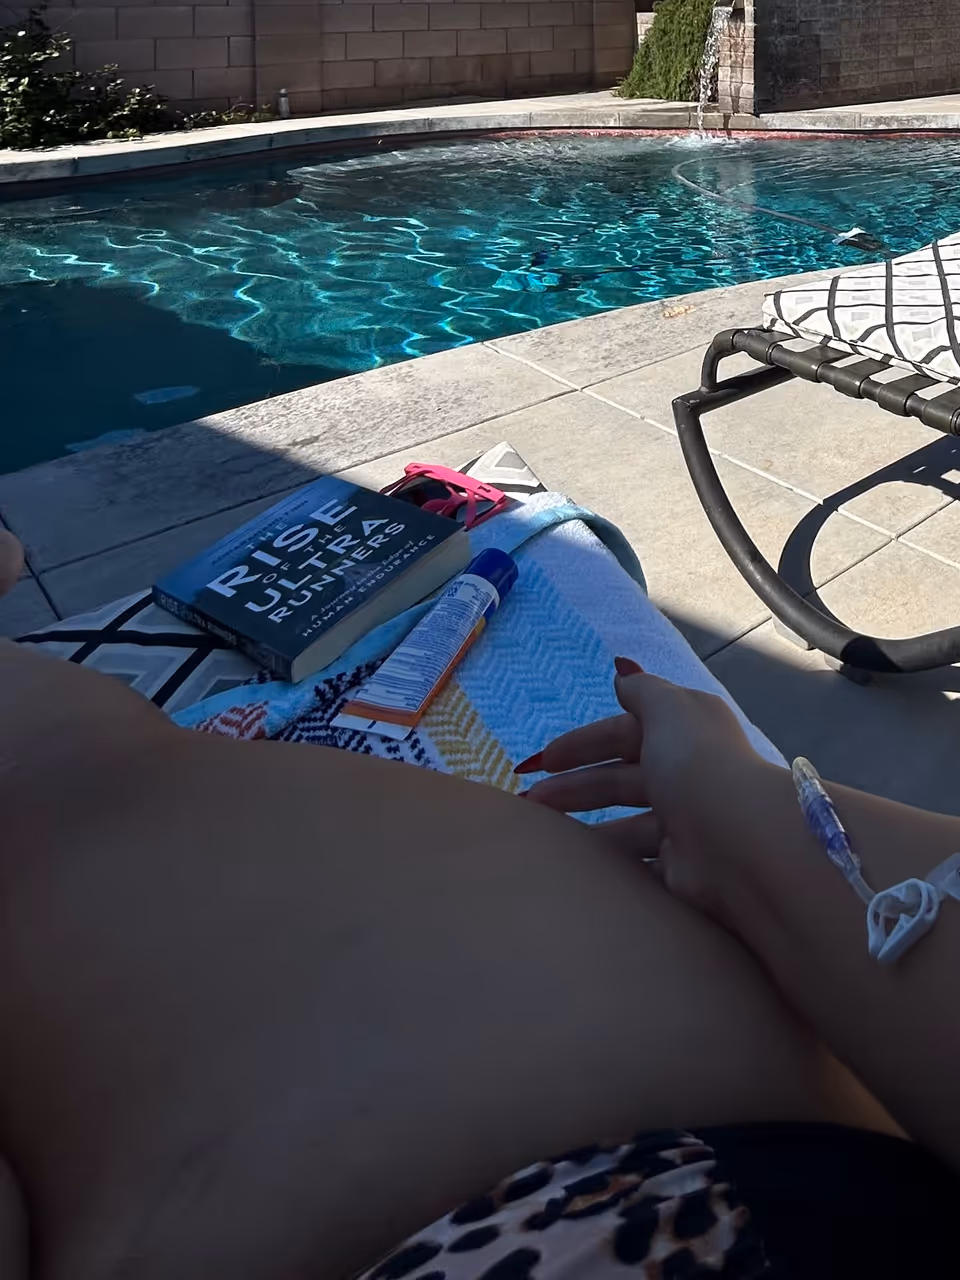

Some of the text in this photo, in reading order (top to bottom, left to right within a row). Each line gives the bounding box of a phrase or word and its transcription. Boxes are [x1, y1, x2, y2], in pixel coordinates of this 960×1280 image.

[206, 499, 358, 598] RISE
[244, 523, 288, 550] THE
[244, 518, 389, 612] ULTRA
[263, 525, 347, 584] OF THE
[268, 522, 406, 624] RUNNERS
[302, 534, 435, 637] HUMAN ENDURANCE
